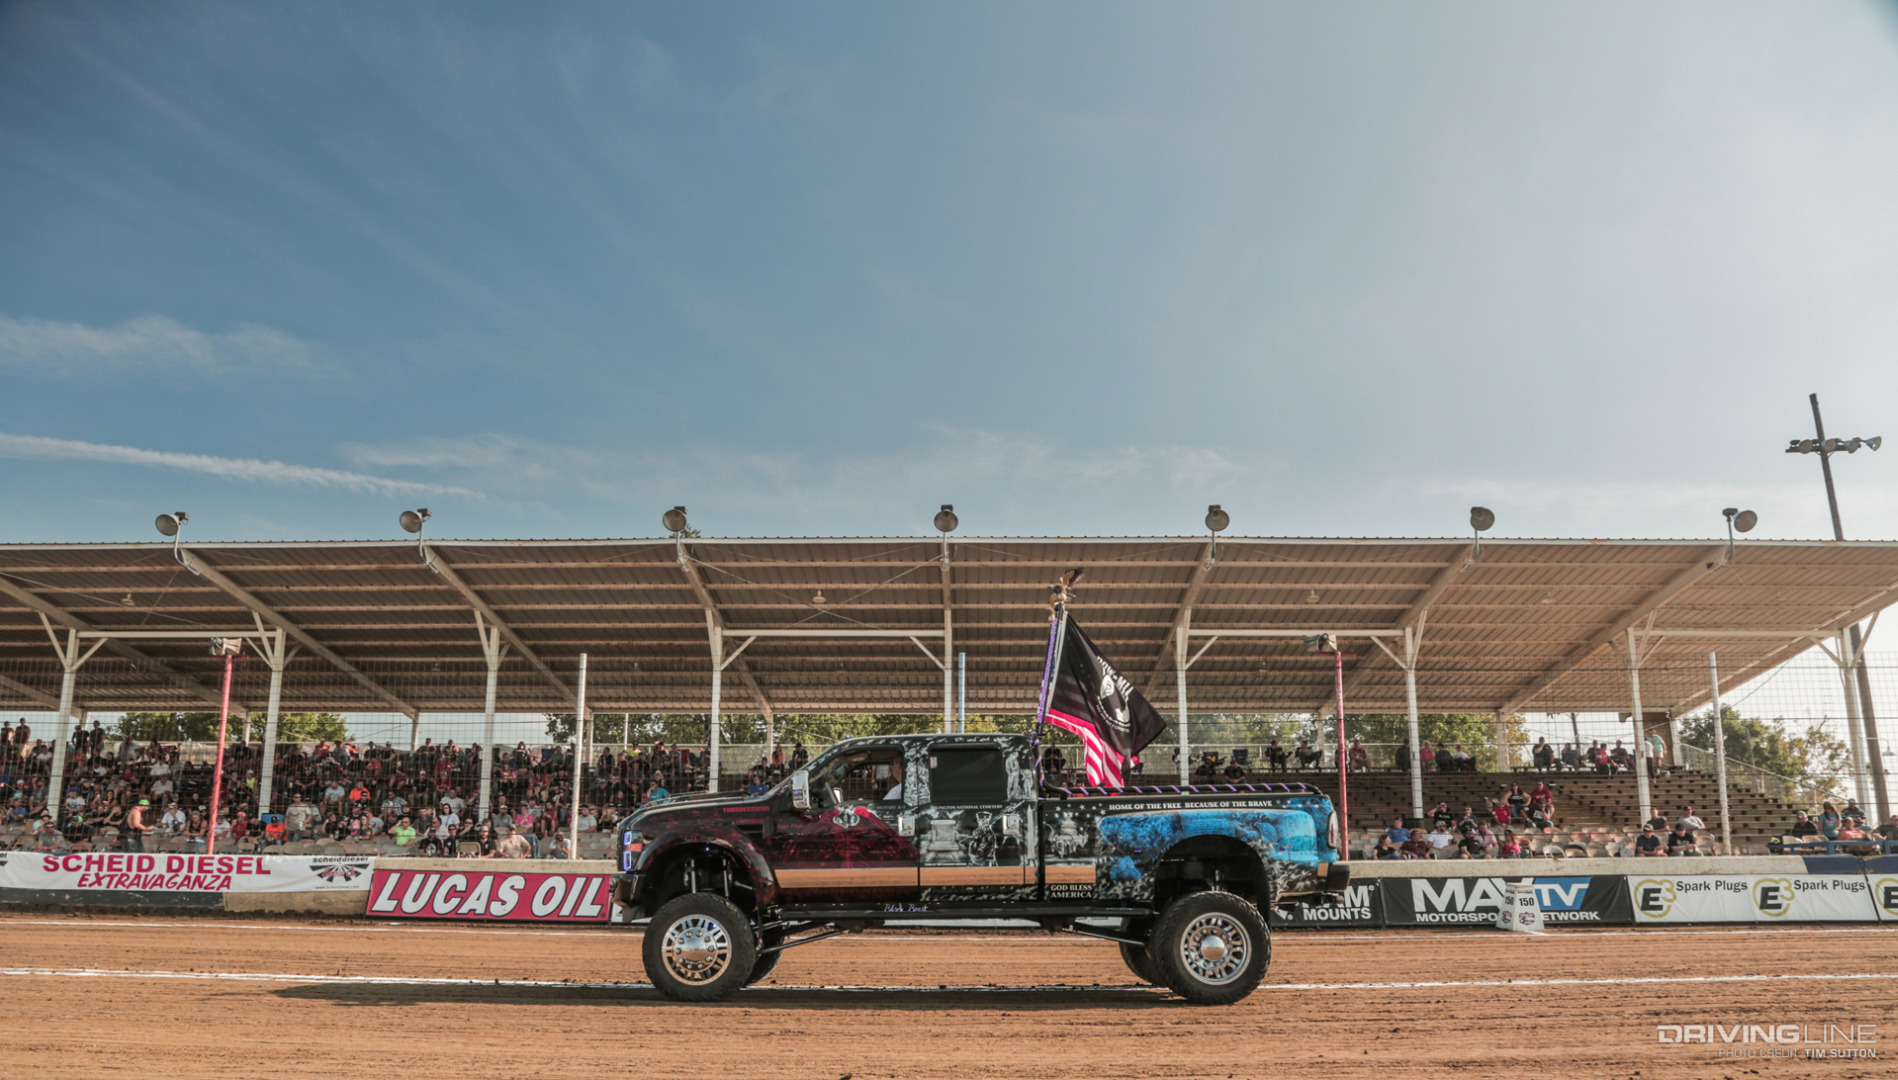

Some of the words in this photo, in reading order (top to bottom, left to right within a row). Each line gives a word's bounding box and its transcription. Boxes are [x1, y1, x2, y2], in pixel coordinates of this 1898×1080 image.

[43, 854, 155, 872] SCHEID
[166, 855, 271, 875] DIESEL
[77, 873, 232, 891] EXTRAVAGANZA
[1676, 881, 1711, 892] Spark
[1715, 880, 1748, 892] Plugs
[1794, 880, 1829, 891] Spark
[1832, 880, 1866, 892] Plugs
[371, 872, 526, 917] LUCAS
[531, 875, 604, 918] OIL
[1519, 897, 1534, 906] 150
[1303, 907, 1372, 920] MOUNTS
[1415, 912, 1498, 922] MOTORSPO
[1542, 911, 1600, 921] ETWORK
